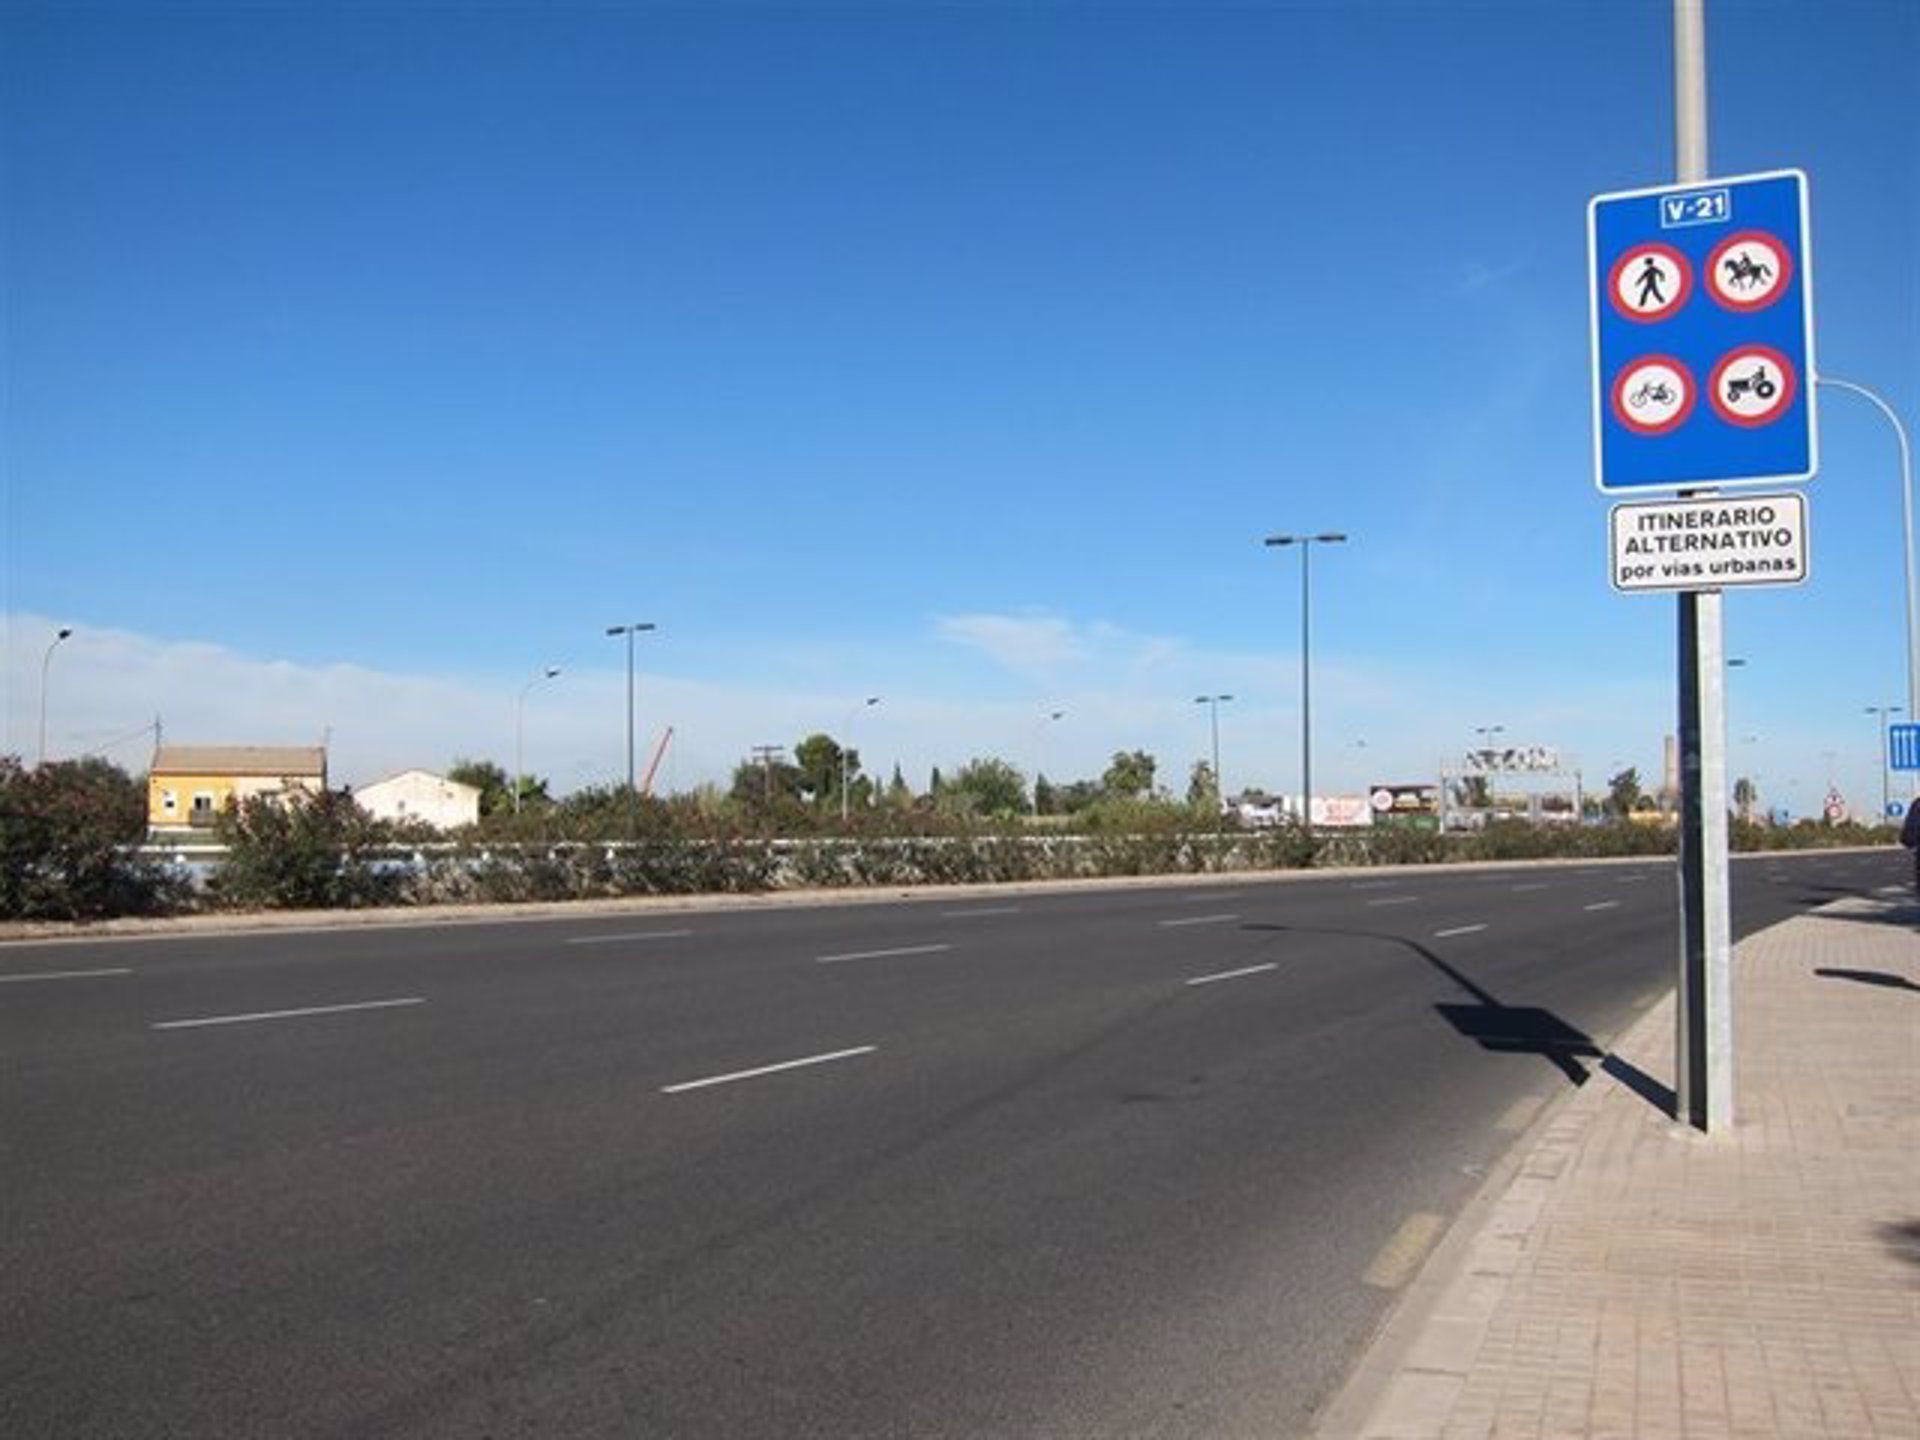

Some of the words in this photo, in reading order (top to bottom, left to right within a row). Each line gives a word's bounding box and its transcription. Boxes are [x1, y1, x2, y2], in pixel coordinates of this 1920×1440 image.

[1668, 194, 1724, 220] V-21
[1637, 506, 1775, 531] ITINERARIO
[1625, 528, 1792, 554] ALTERNATIVO
[1621, 564, 1654, 582] por
[1709, 556, 1797, 575] urbanas
